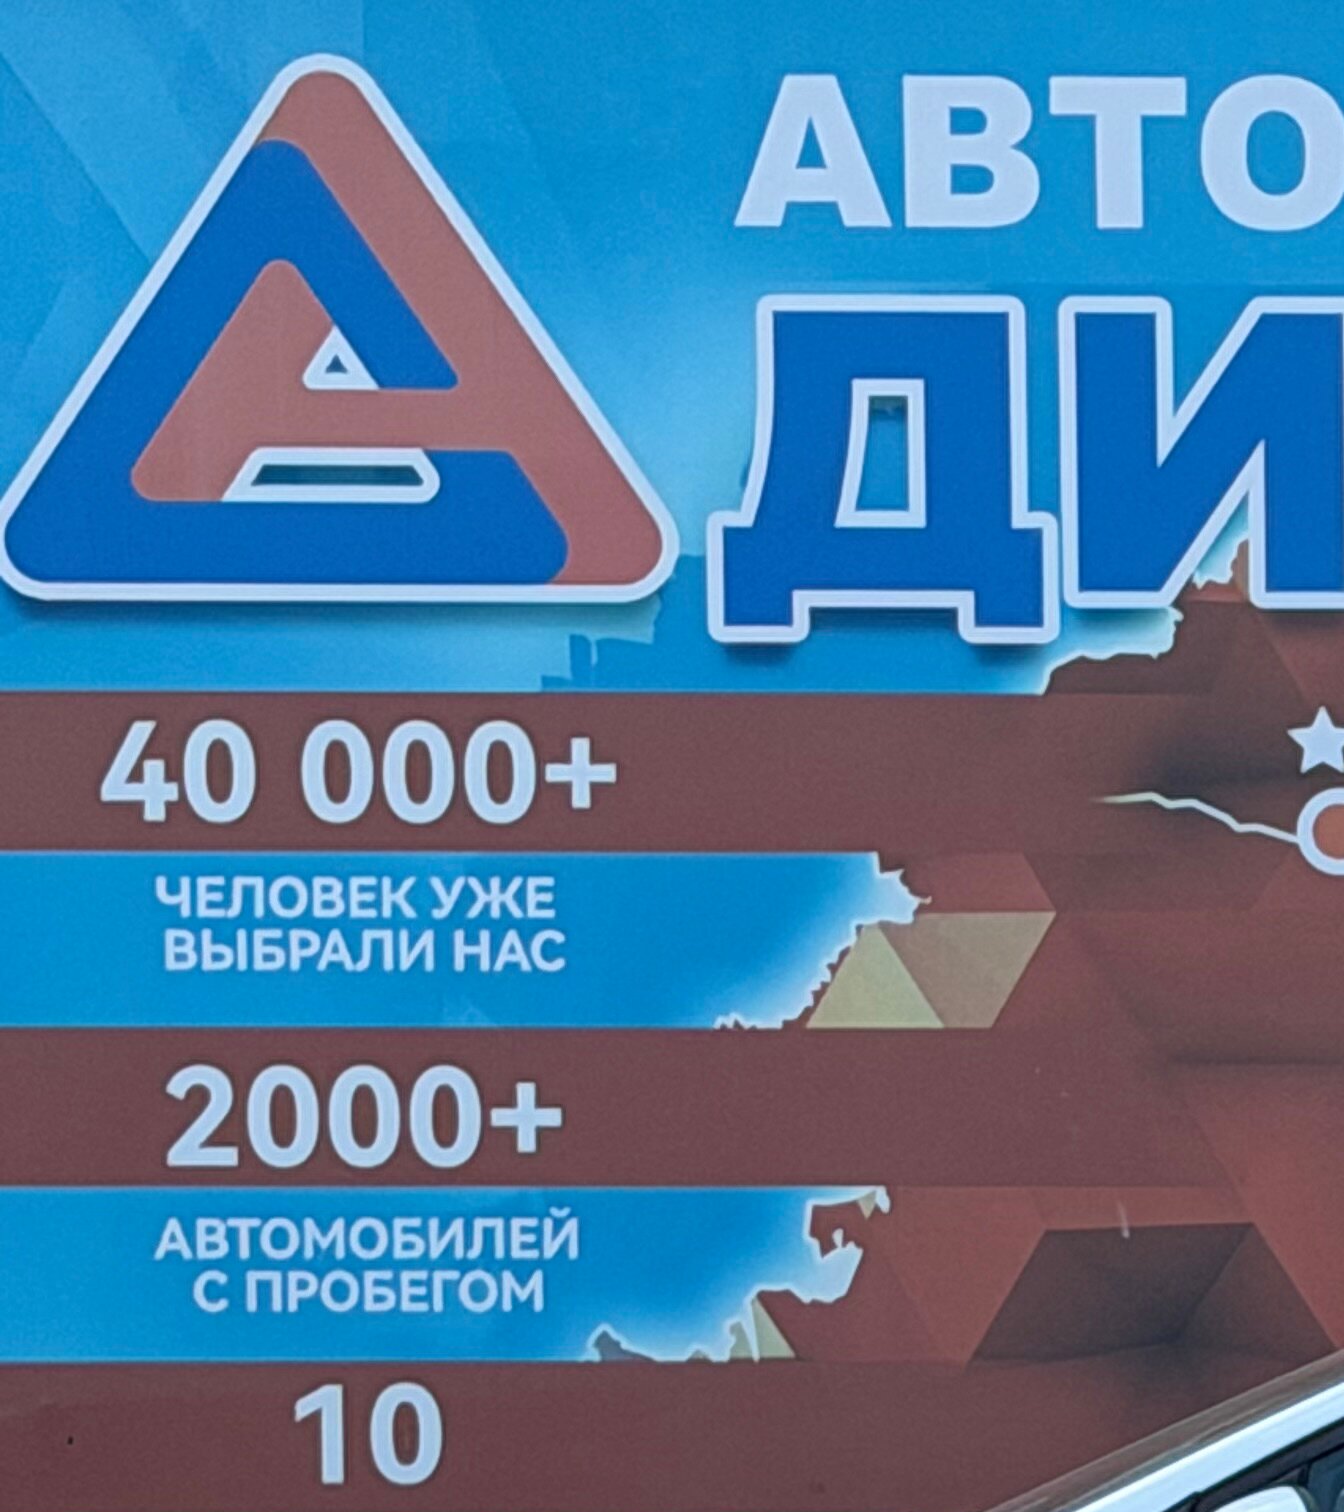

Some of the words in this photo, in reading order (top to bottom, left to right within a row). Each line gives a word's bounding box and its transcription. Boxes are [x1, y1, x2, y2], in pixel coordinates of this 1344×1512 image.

[100, 718, 257, 824] 40
[300, 718, 618, 824] 000+
[155, 875, 418, 919] ЧЕЛОВЕК
[429, 875, 556, 920] УЖЕ
[164, 928, 435, 972] ВЫБРАЛИ
[453, 928, 566, 972] НАС
[165, 1064, 563, 1169] 2000+
[154, 1207, 579, 1261] АВТОМОБИЛЕЙ
[192, 1269, 229, 1313] С
[245, 1269, 544, 1313] ПРОБЕГОМ
[294, 1381, 443, 1485] 10
